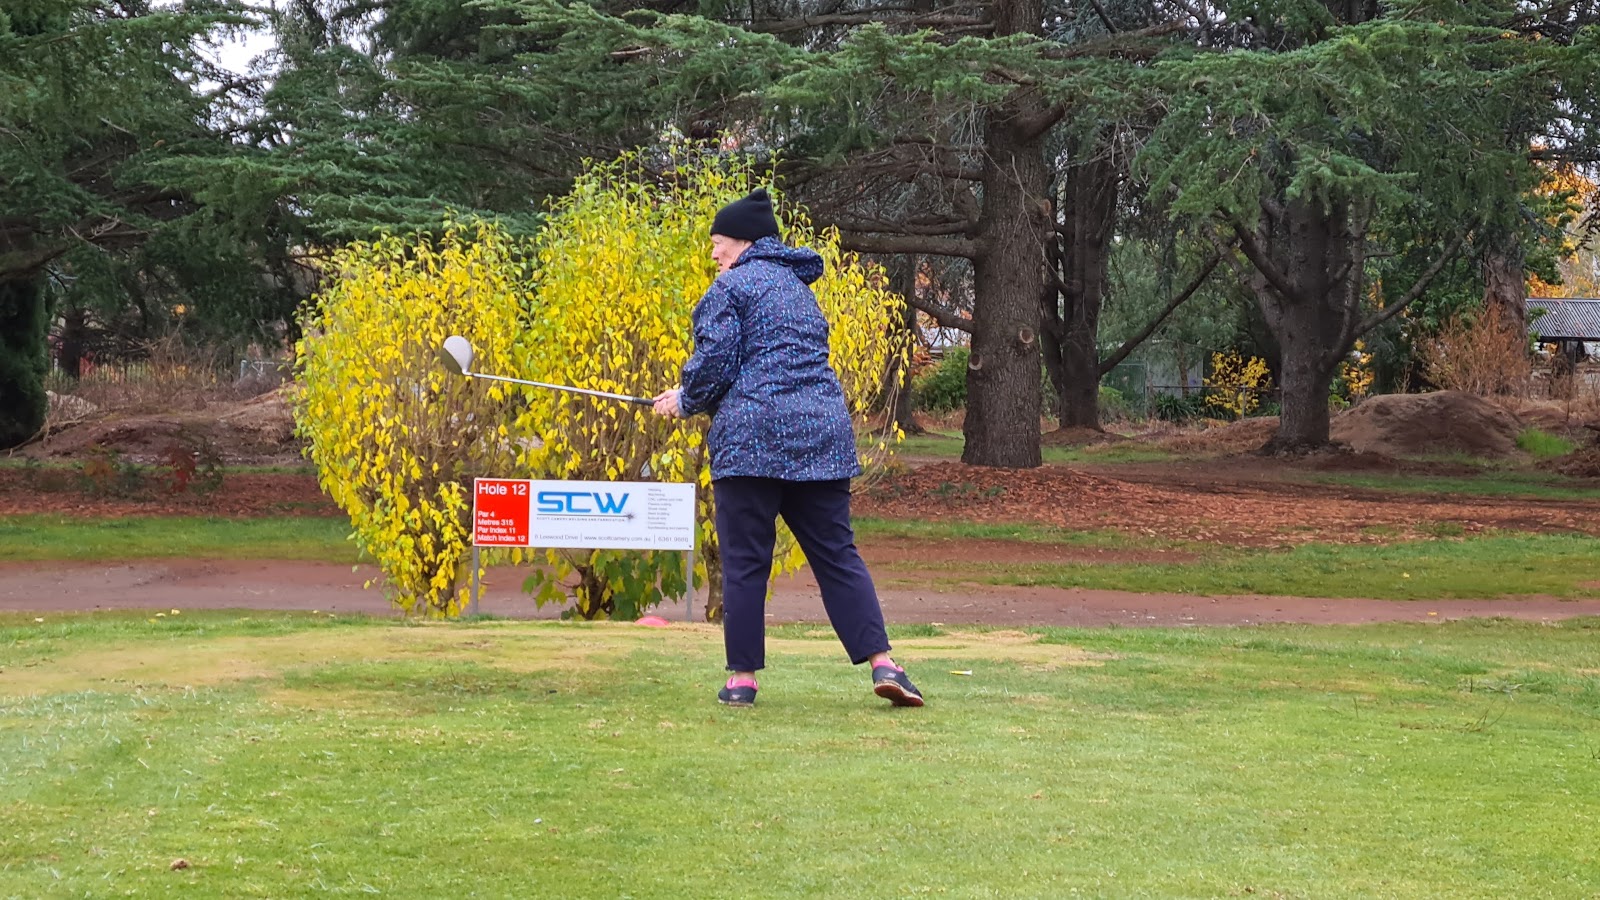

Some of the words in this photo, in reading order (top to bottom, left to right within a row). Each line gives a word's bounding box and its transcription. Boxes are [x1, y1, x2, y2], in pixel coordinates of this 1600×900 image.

[478, 482, 507, 495] Hole
[511, 483, 526, 496] 12
[537, 491, 629, 513] SCW
[477, 510, 489, 518] Par
[477, 518, 500, 526] Metres
[477, 526, 489, 534] Par
[489, 526, 507, 534] Index
[477, 534, 497, 542] Match
